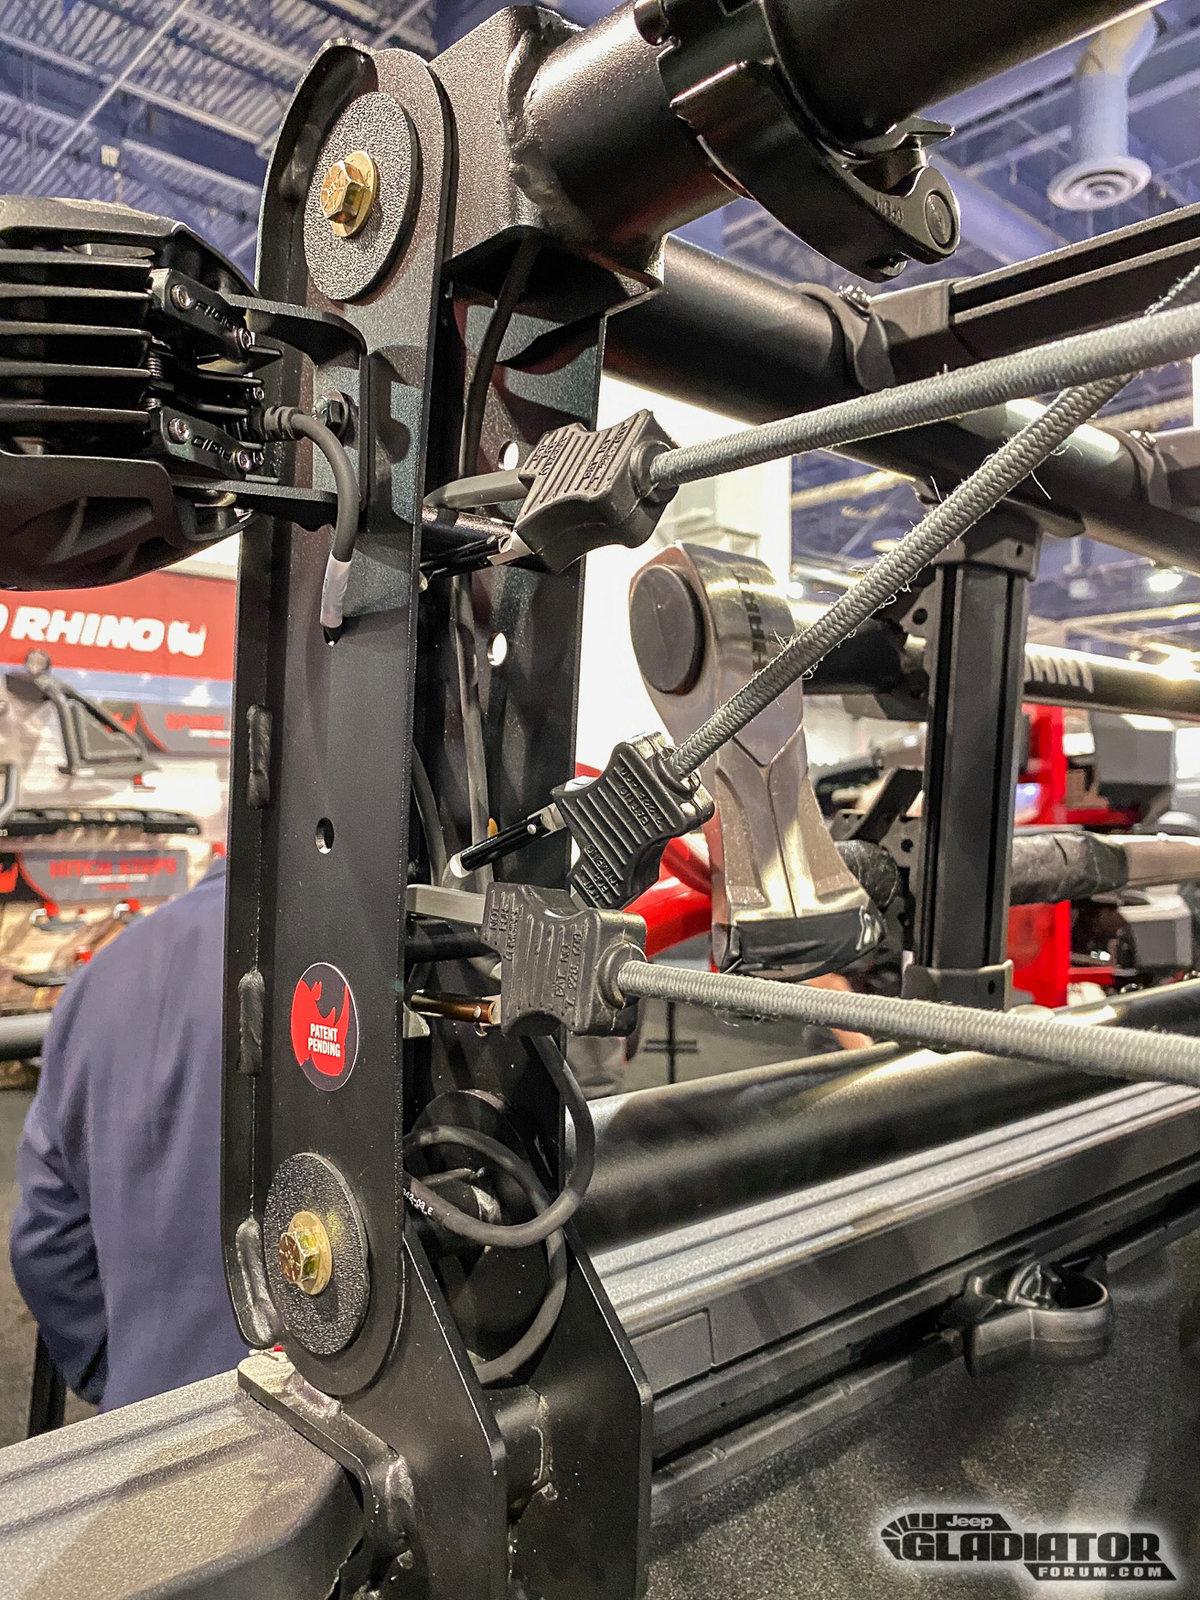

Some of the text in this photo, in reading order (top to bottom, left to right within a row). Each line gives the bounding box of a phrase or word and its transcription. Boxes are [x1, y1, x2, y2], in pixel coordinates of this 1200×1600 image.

[10, 606, 165, 652] RHINO
[309, 1023, 338, 1042] PATENT
[308, 1037, 341, 1058] PENDING
